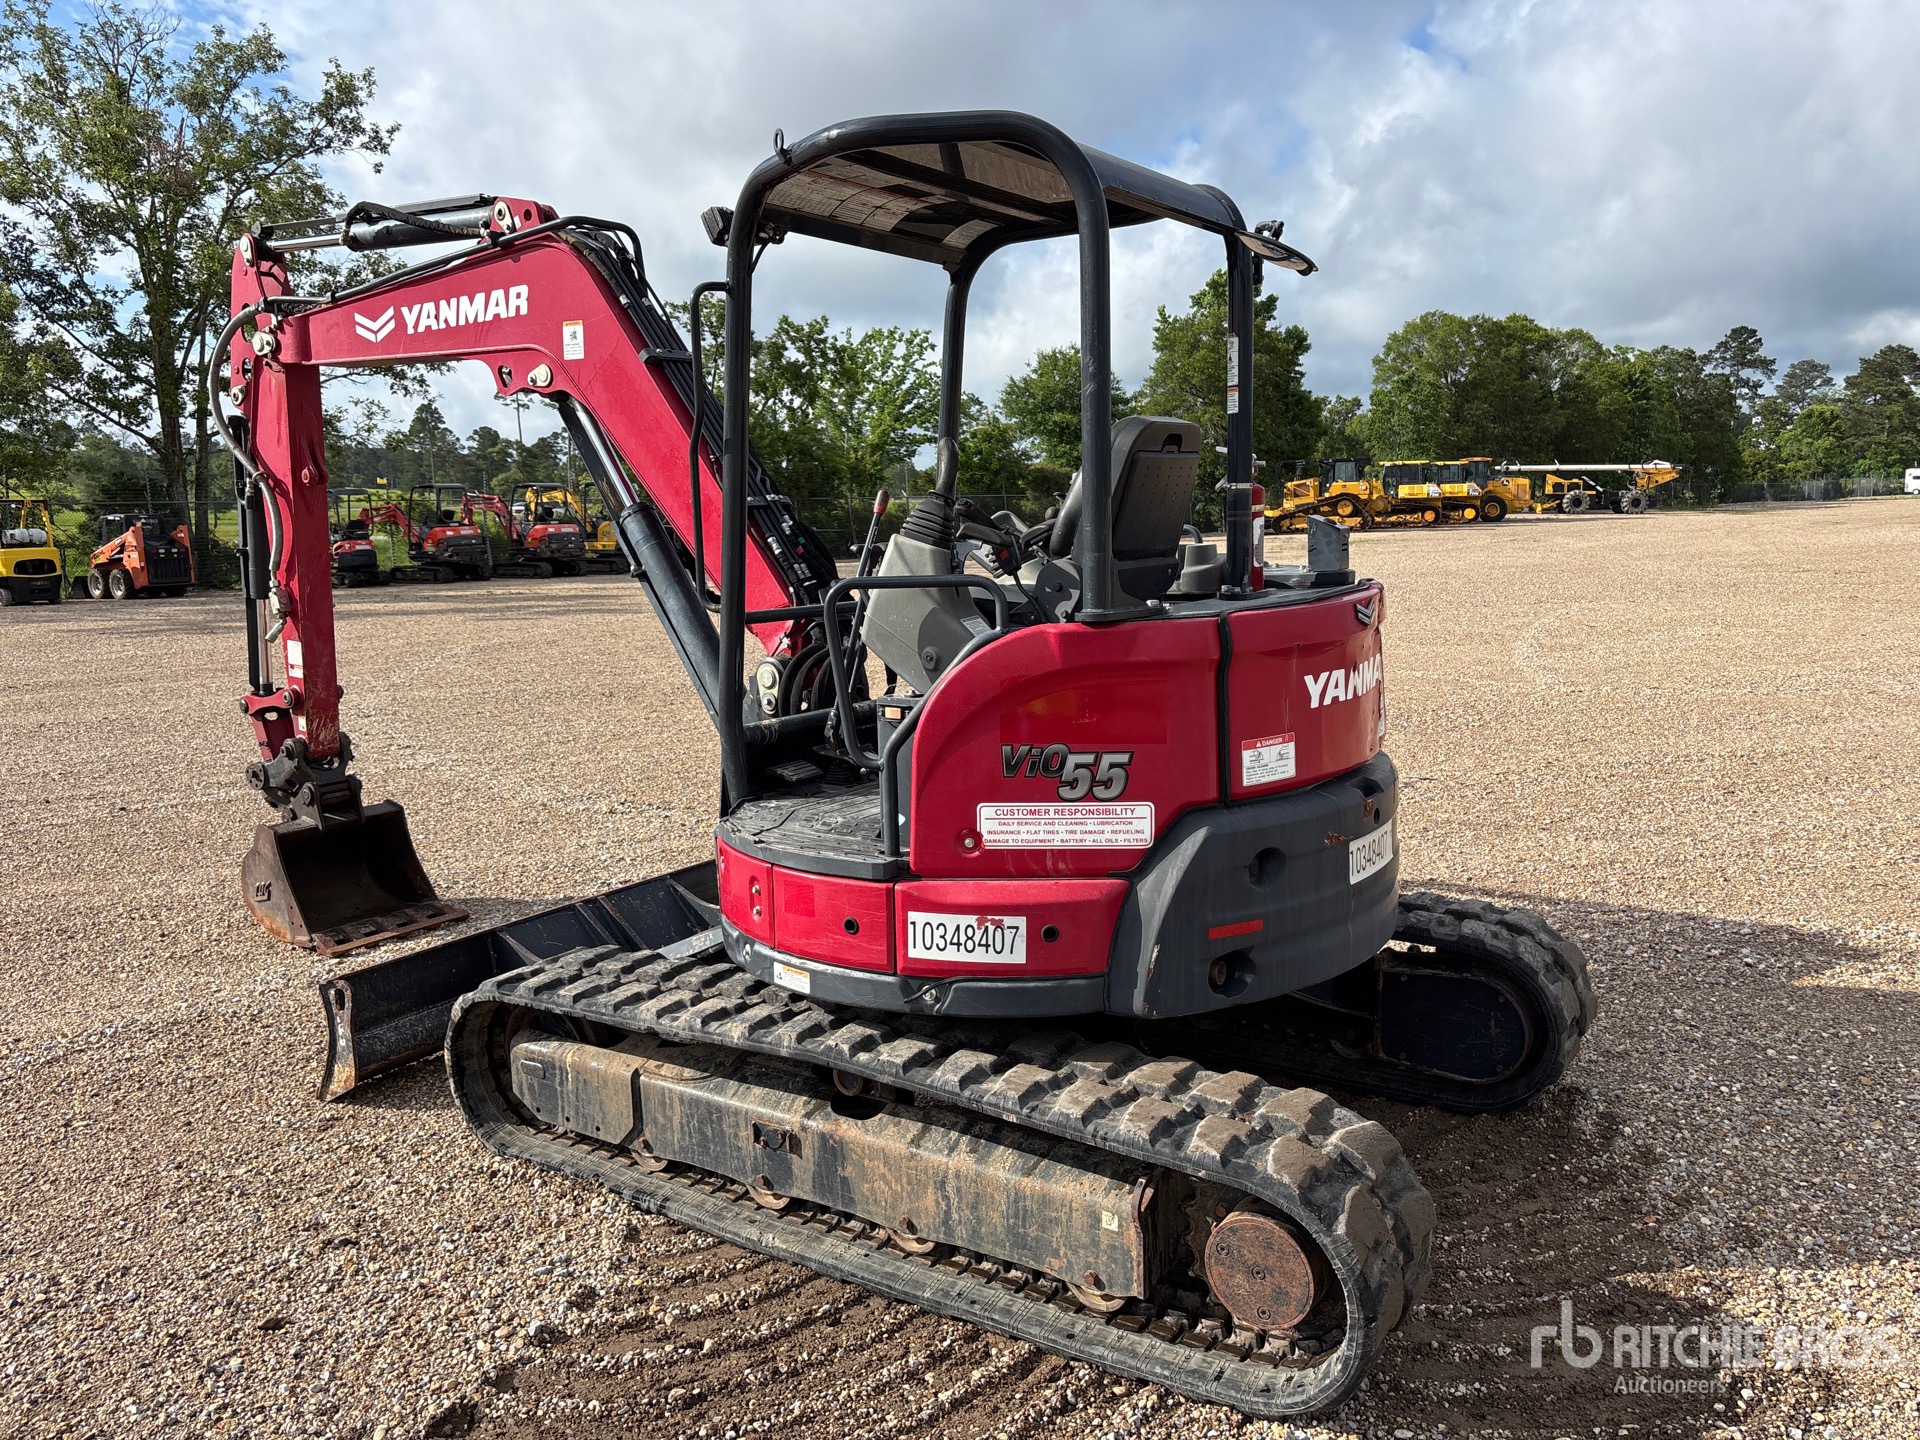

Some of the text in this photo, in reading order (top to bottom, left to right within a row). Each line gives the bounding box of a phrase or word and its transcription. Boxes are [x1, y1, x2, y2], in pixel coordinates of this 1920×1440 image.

[400, 284, 529, 335] YANMAR
[1262, 738, 1283, 746] DANGER
[995, 807, 1136, 817] CUSTOMER RESPONSIBILITY
[1350, 830, 1388, 877] 10348407
[910, 921, 1020, 955] 10348407
